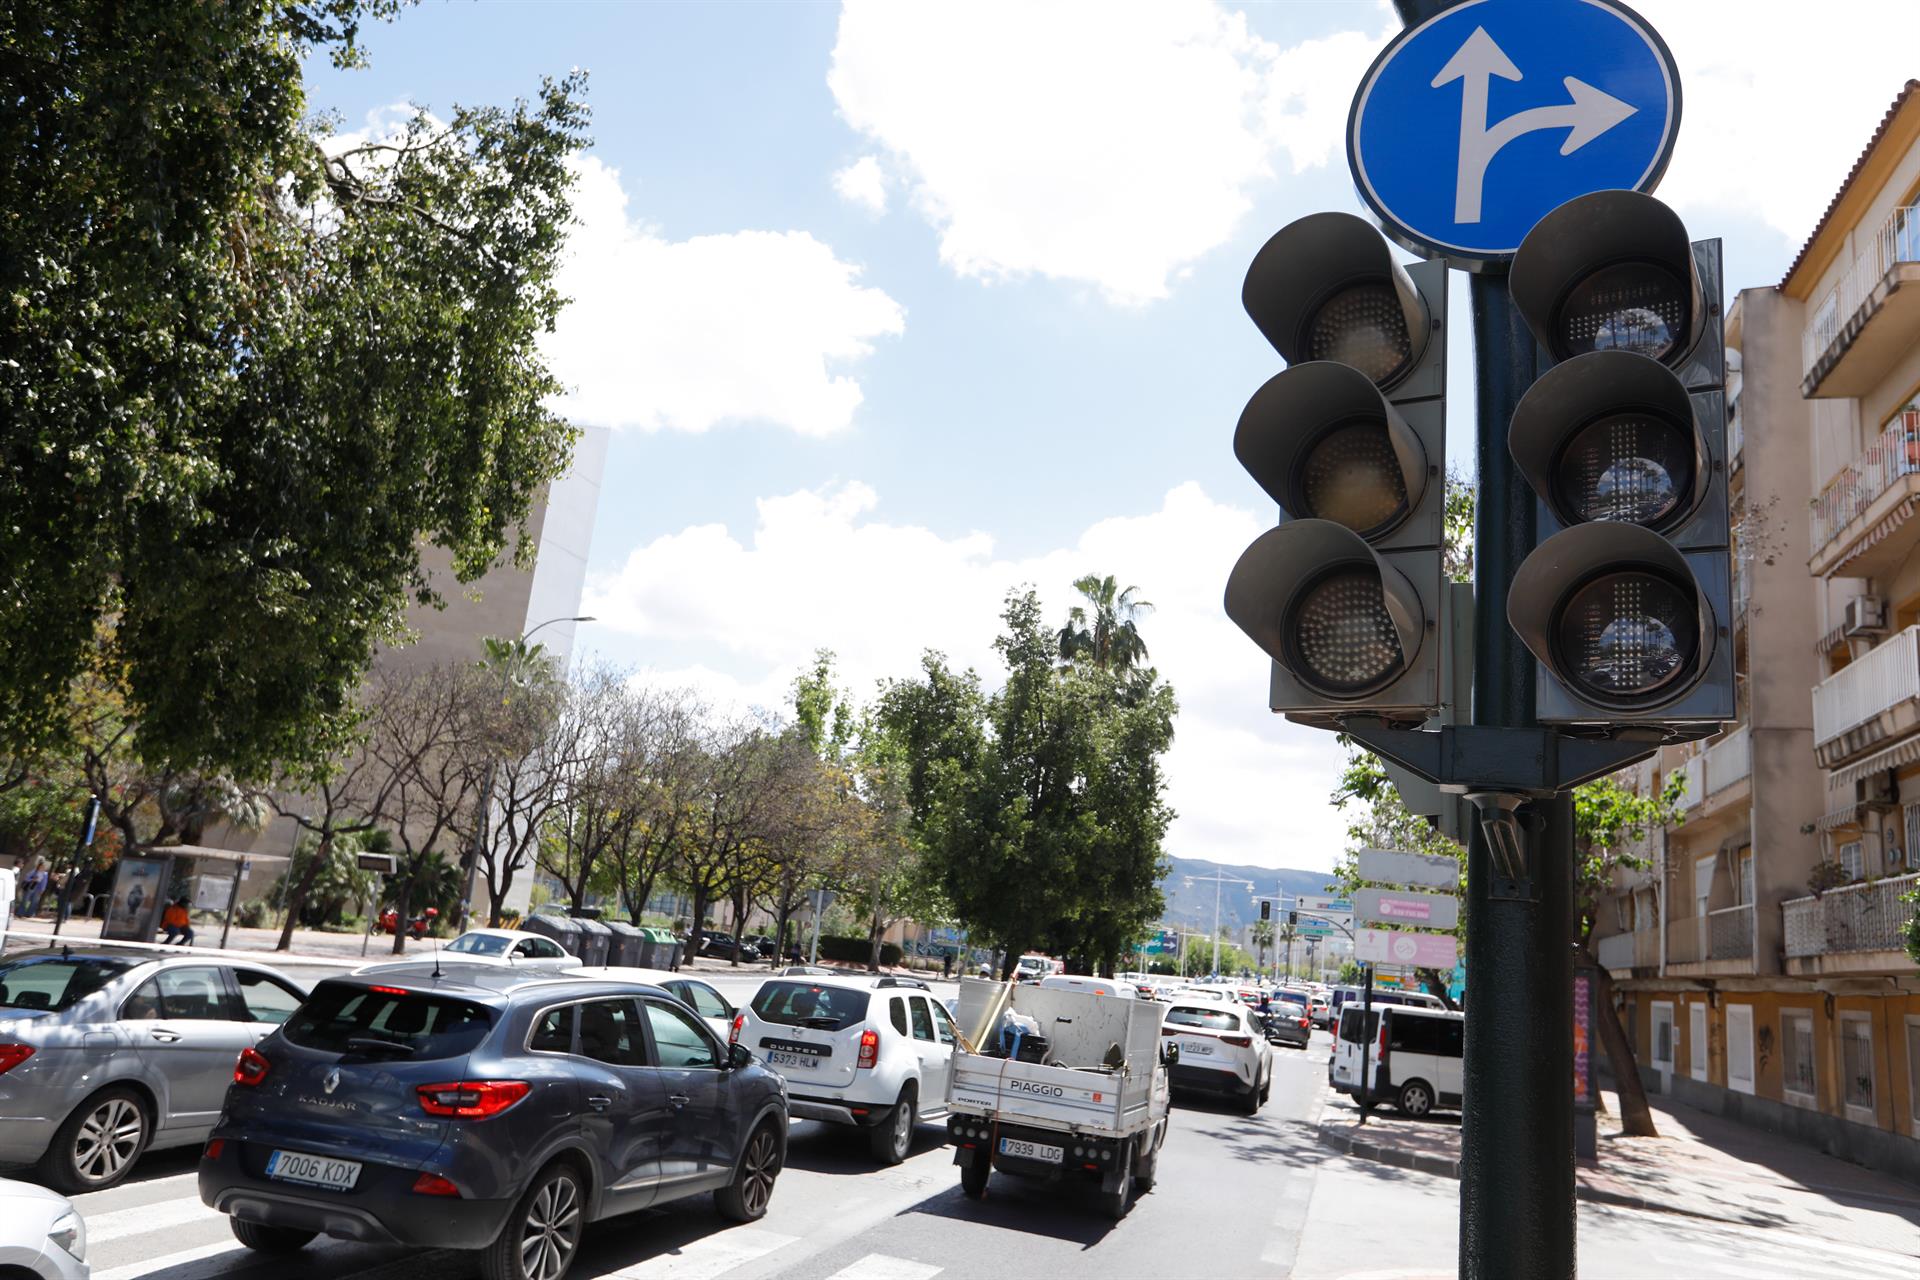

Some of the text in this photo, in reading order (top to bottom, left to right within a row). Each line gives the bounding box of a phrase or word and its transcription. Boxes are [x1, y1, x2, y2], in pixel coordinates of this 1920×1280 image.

[770, 1044, 818, 1054] DUSTER
[773, 1053, 818, 1068] 5373 HLM
[1010, 1080, 1063, 1097] PIAGGIO
[298, 1096, 358, 1111] KADJAR
[957, 1097, 992, 1106] PORTER
[1007, 1141, 1061, 1161] 7939 LDG
[279, 1155, 321, 1178] 7006
[322, 1161, 358, 1185] KDX
